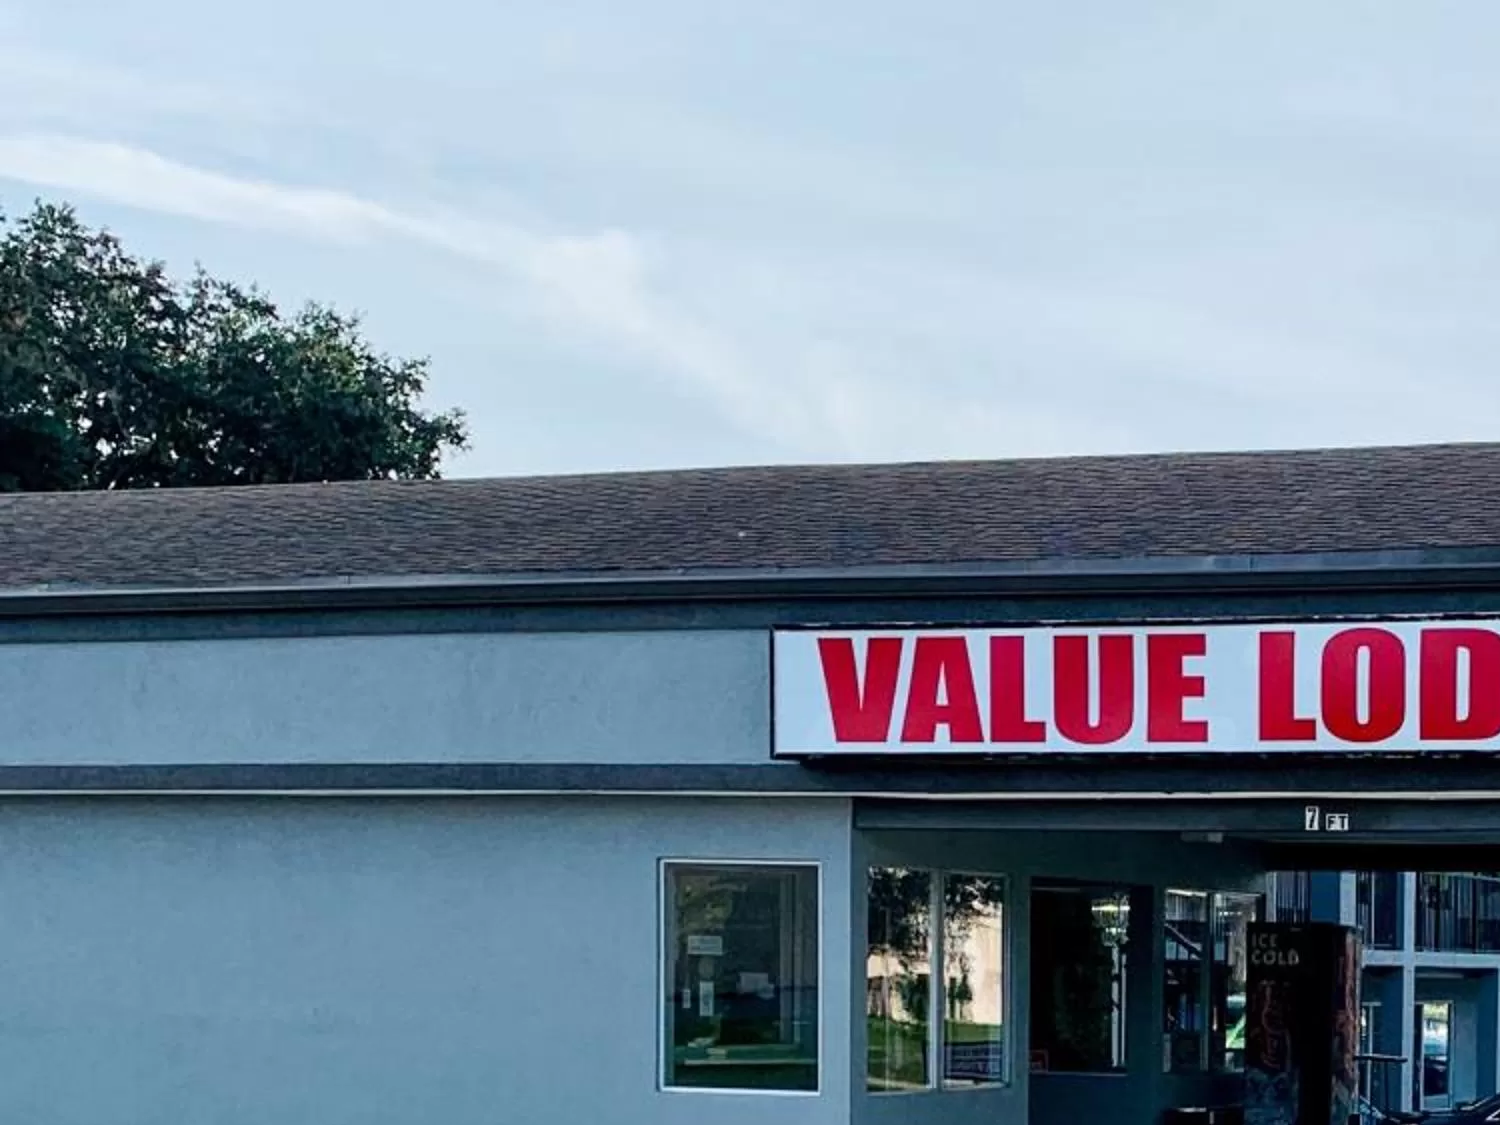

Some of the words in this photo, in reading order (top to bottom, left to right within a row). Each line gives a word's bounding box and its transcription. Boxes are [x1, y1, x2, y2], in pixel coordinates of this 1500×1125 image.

[820, 635, 1208, 743] VALUE
[1306, 807, 1318, 829] 7
[1327, 815, 1347, 829] FT
